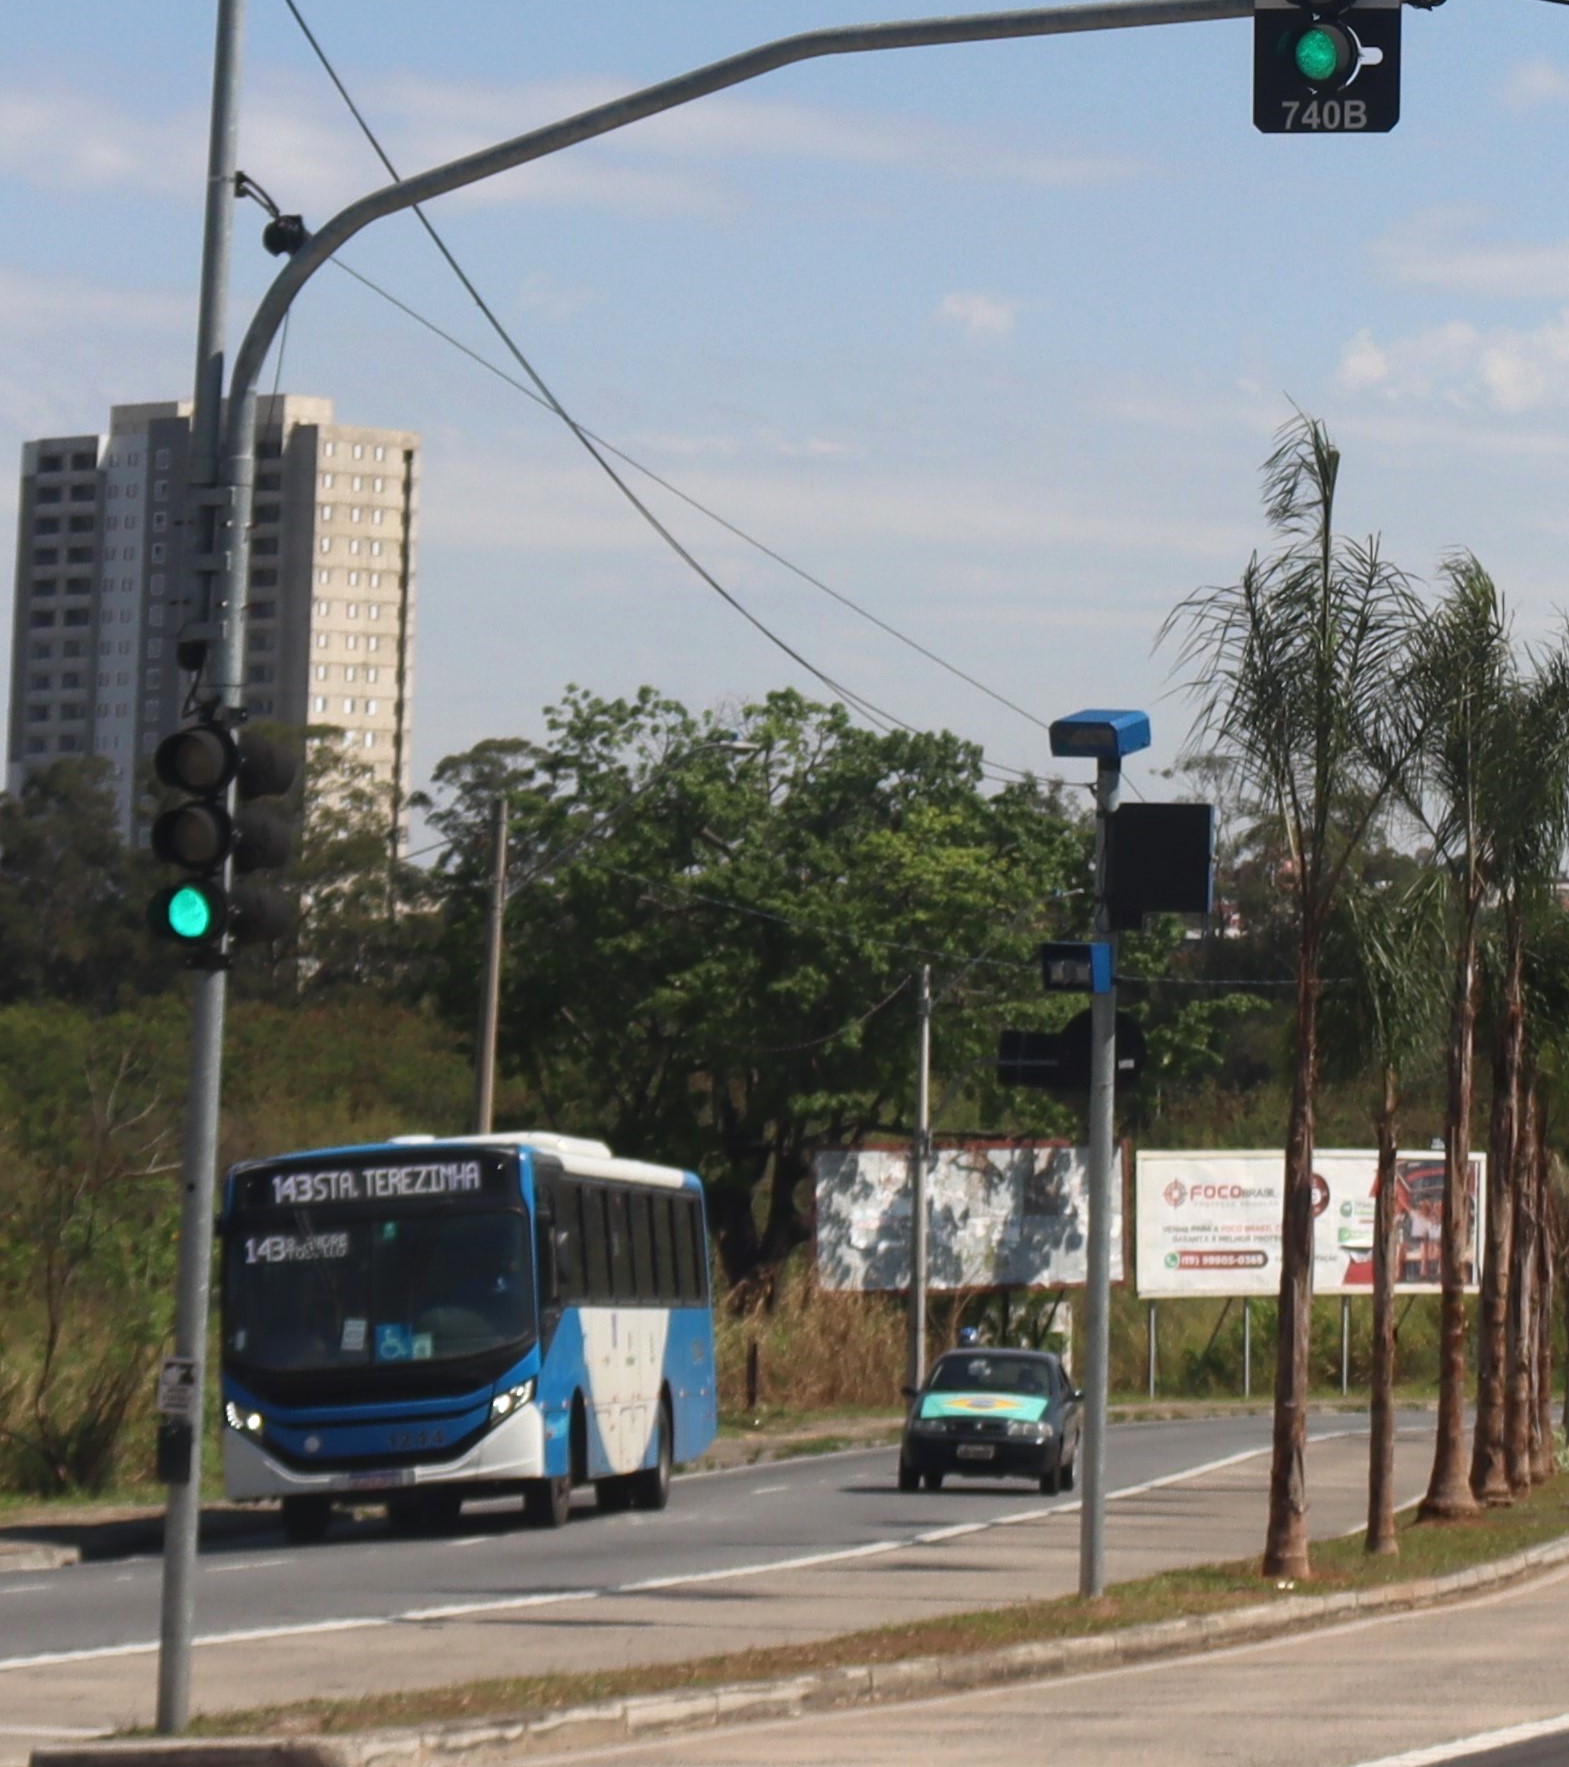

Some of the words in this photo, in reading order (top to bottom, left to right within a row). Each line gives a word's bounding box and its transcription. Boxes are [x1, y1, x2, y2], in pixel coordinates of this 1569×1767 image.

[1281, 100, 1368, 130] 740B
[271, 1174, 313, 1205] 143
[362, 1161, 482, 1197] TEREZINHA
[1190, 1184, 1243, 1202] FOCO
[244, 1236, 287, 1265] 143
